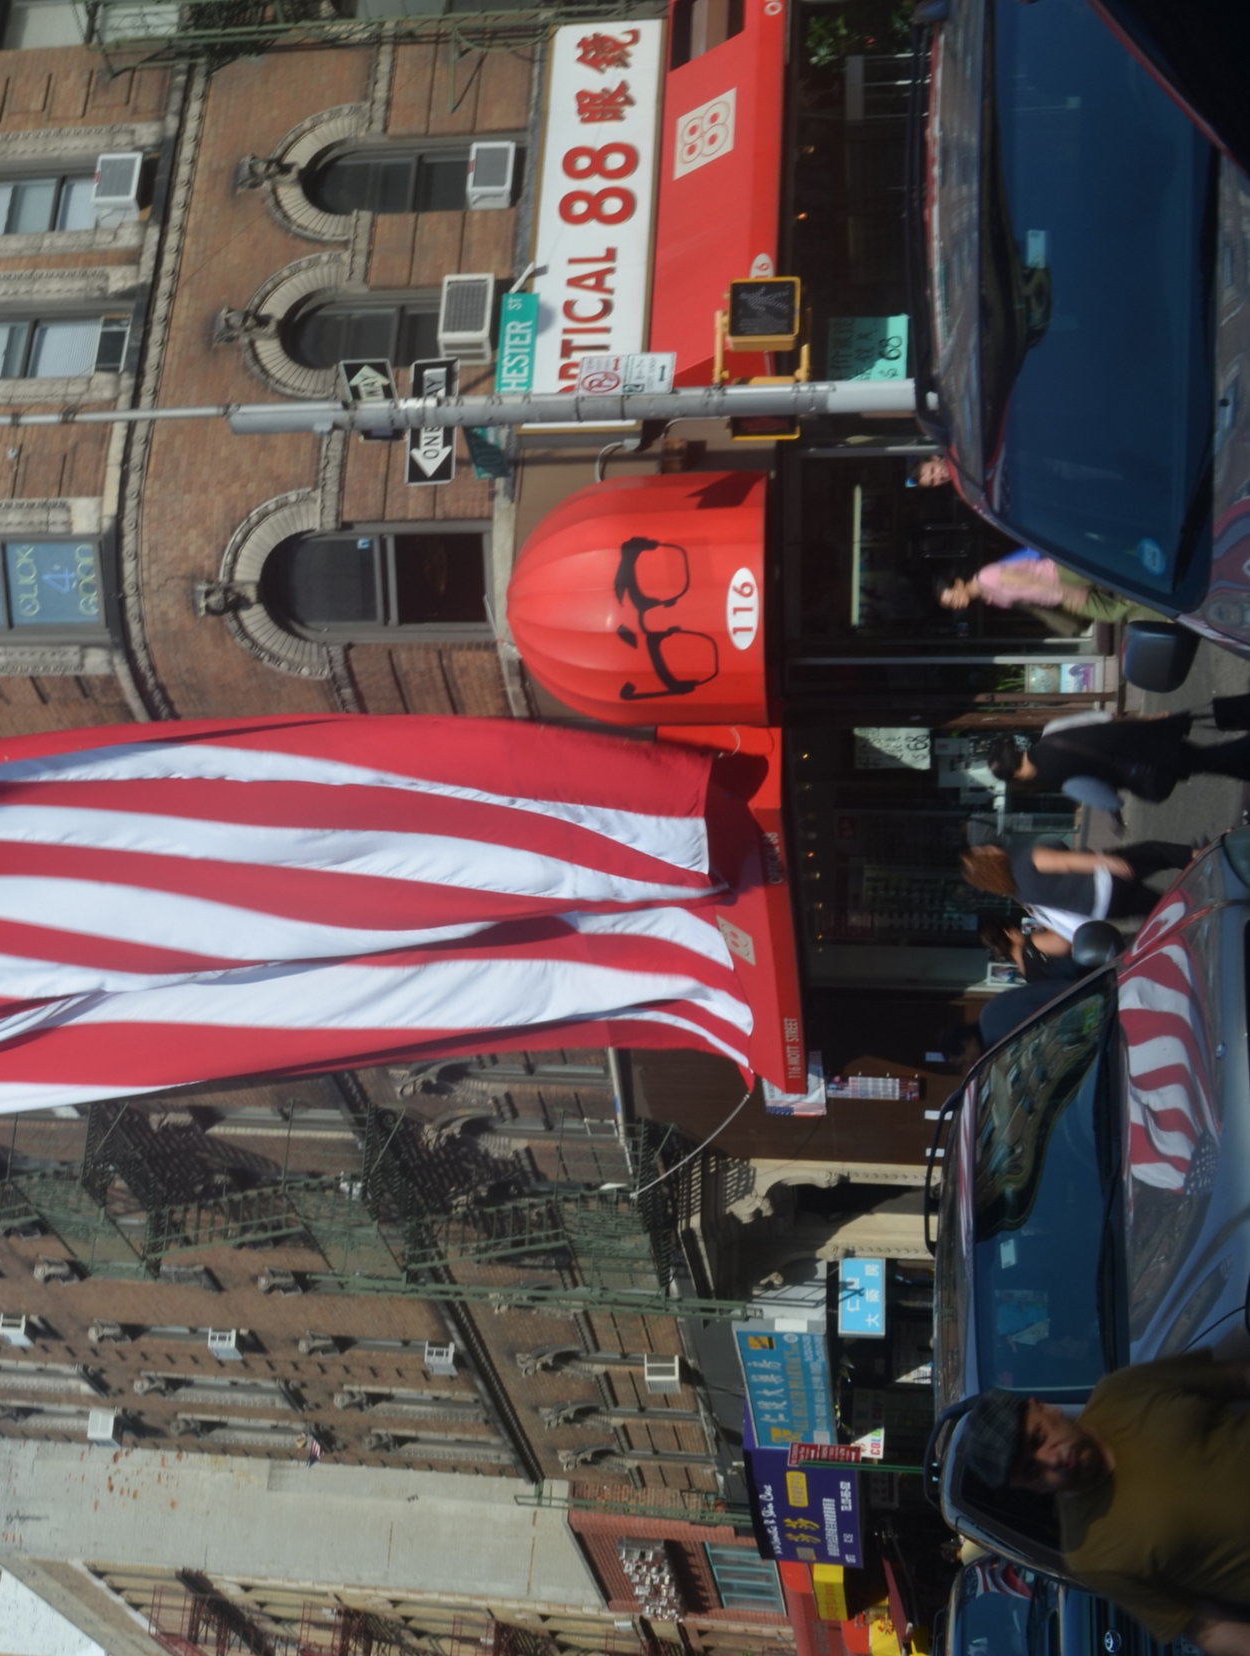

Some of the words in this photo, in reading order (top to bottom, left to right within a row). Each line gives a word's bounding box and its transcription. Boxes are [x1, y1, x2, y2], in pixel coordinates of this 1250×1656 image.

[574, 28, 640, 125] 眼鏡
[558, 141, 639, 226] 88
[507, 297, 523, 311] ST
[557, 246, 619, 393] TICAL
[500, 320, 533, 391] HESTER
[878, 336, 902, 361] 68
[41, 568, 75, 593] 4
[732, 581, 754, 635] 116
[906, 735, 929, 751] 68
[783, 1017, 799, 1043] STREET
[786, 1045, 801, 1065] MOTT
[788, 1066, 801, 1079] 116
